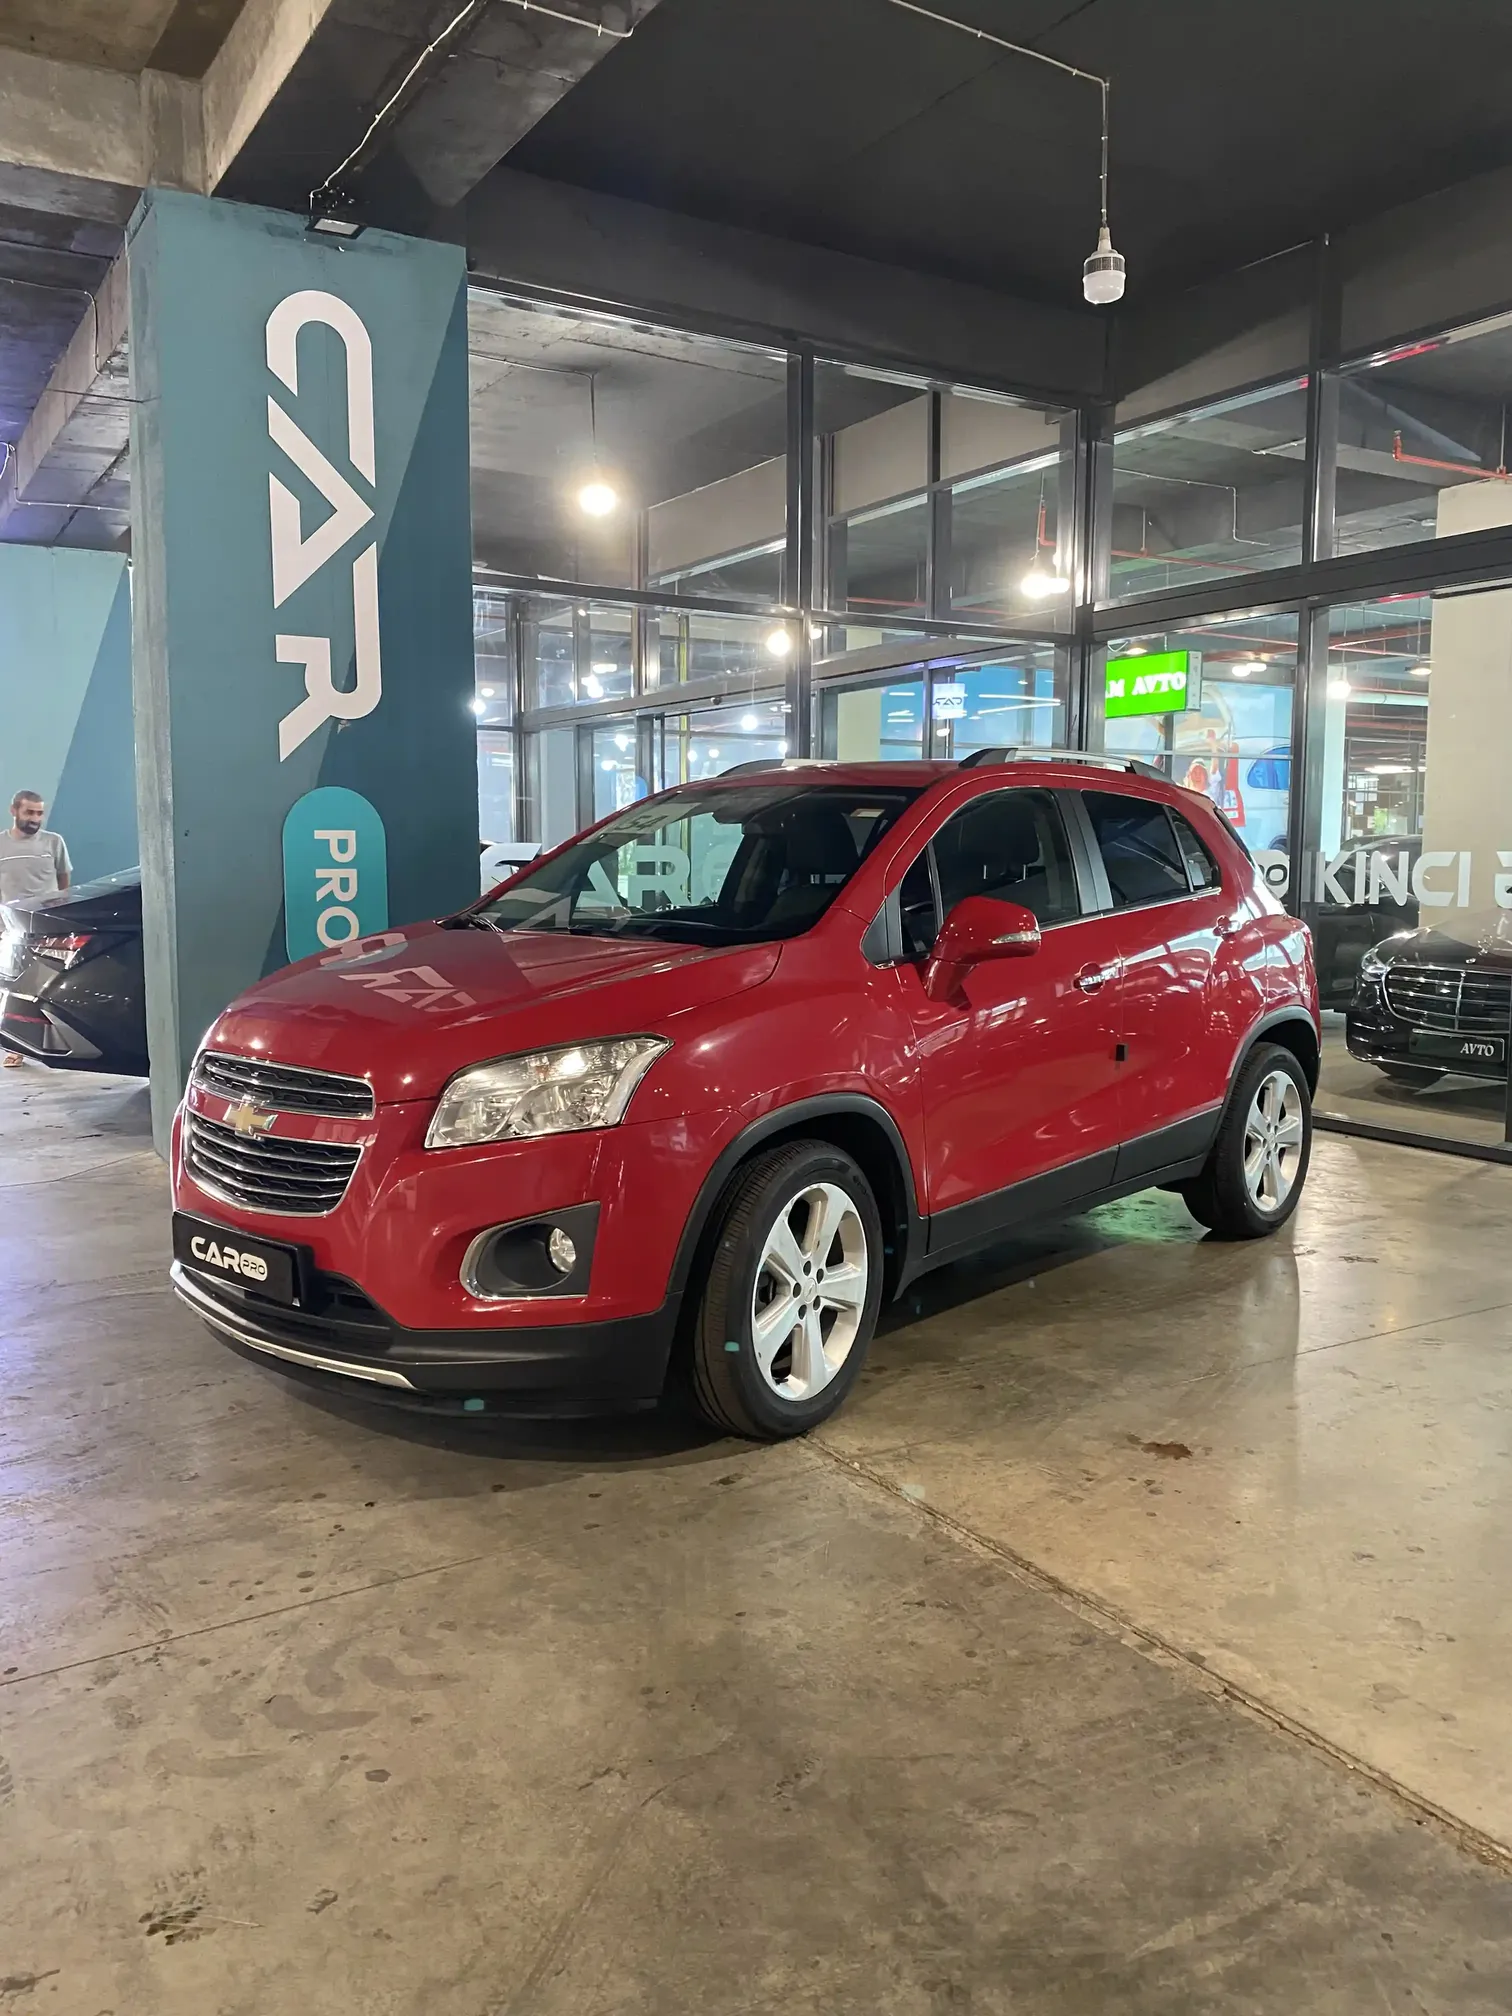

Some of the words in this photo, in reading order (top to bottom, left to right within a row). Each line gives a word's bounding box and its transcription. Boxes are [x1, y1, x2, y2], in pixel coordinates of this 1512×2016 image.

[265, 290, 383, 763] CAR
[1105, 678, 1126, 699] M
[1131, 670, 1187, 696] AVTO
[313, 829, 360, 950] PRO
[1459, 1042, 1495, 1057] AVTO
